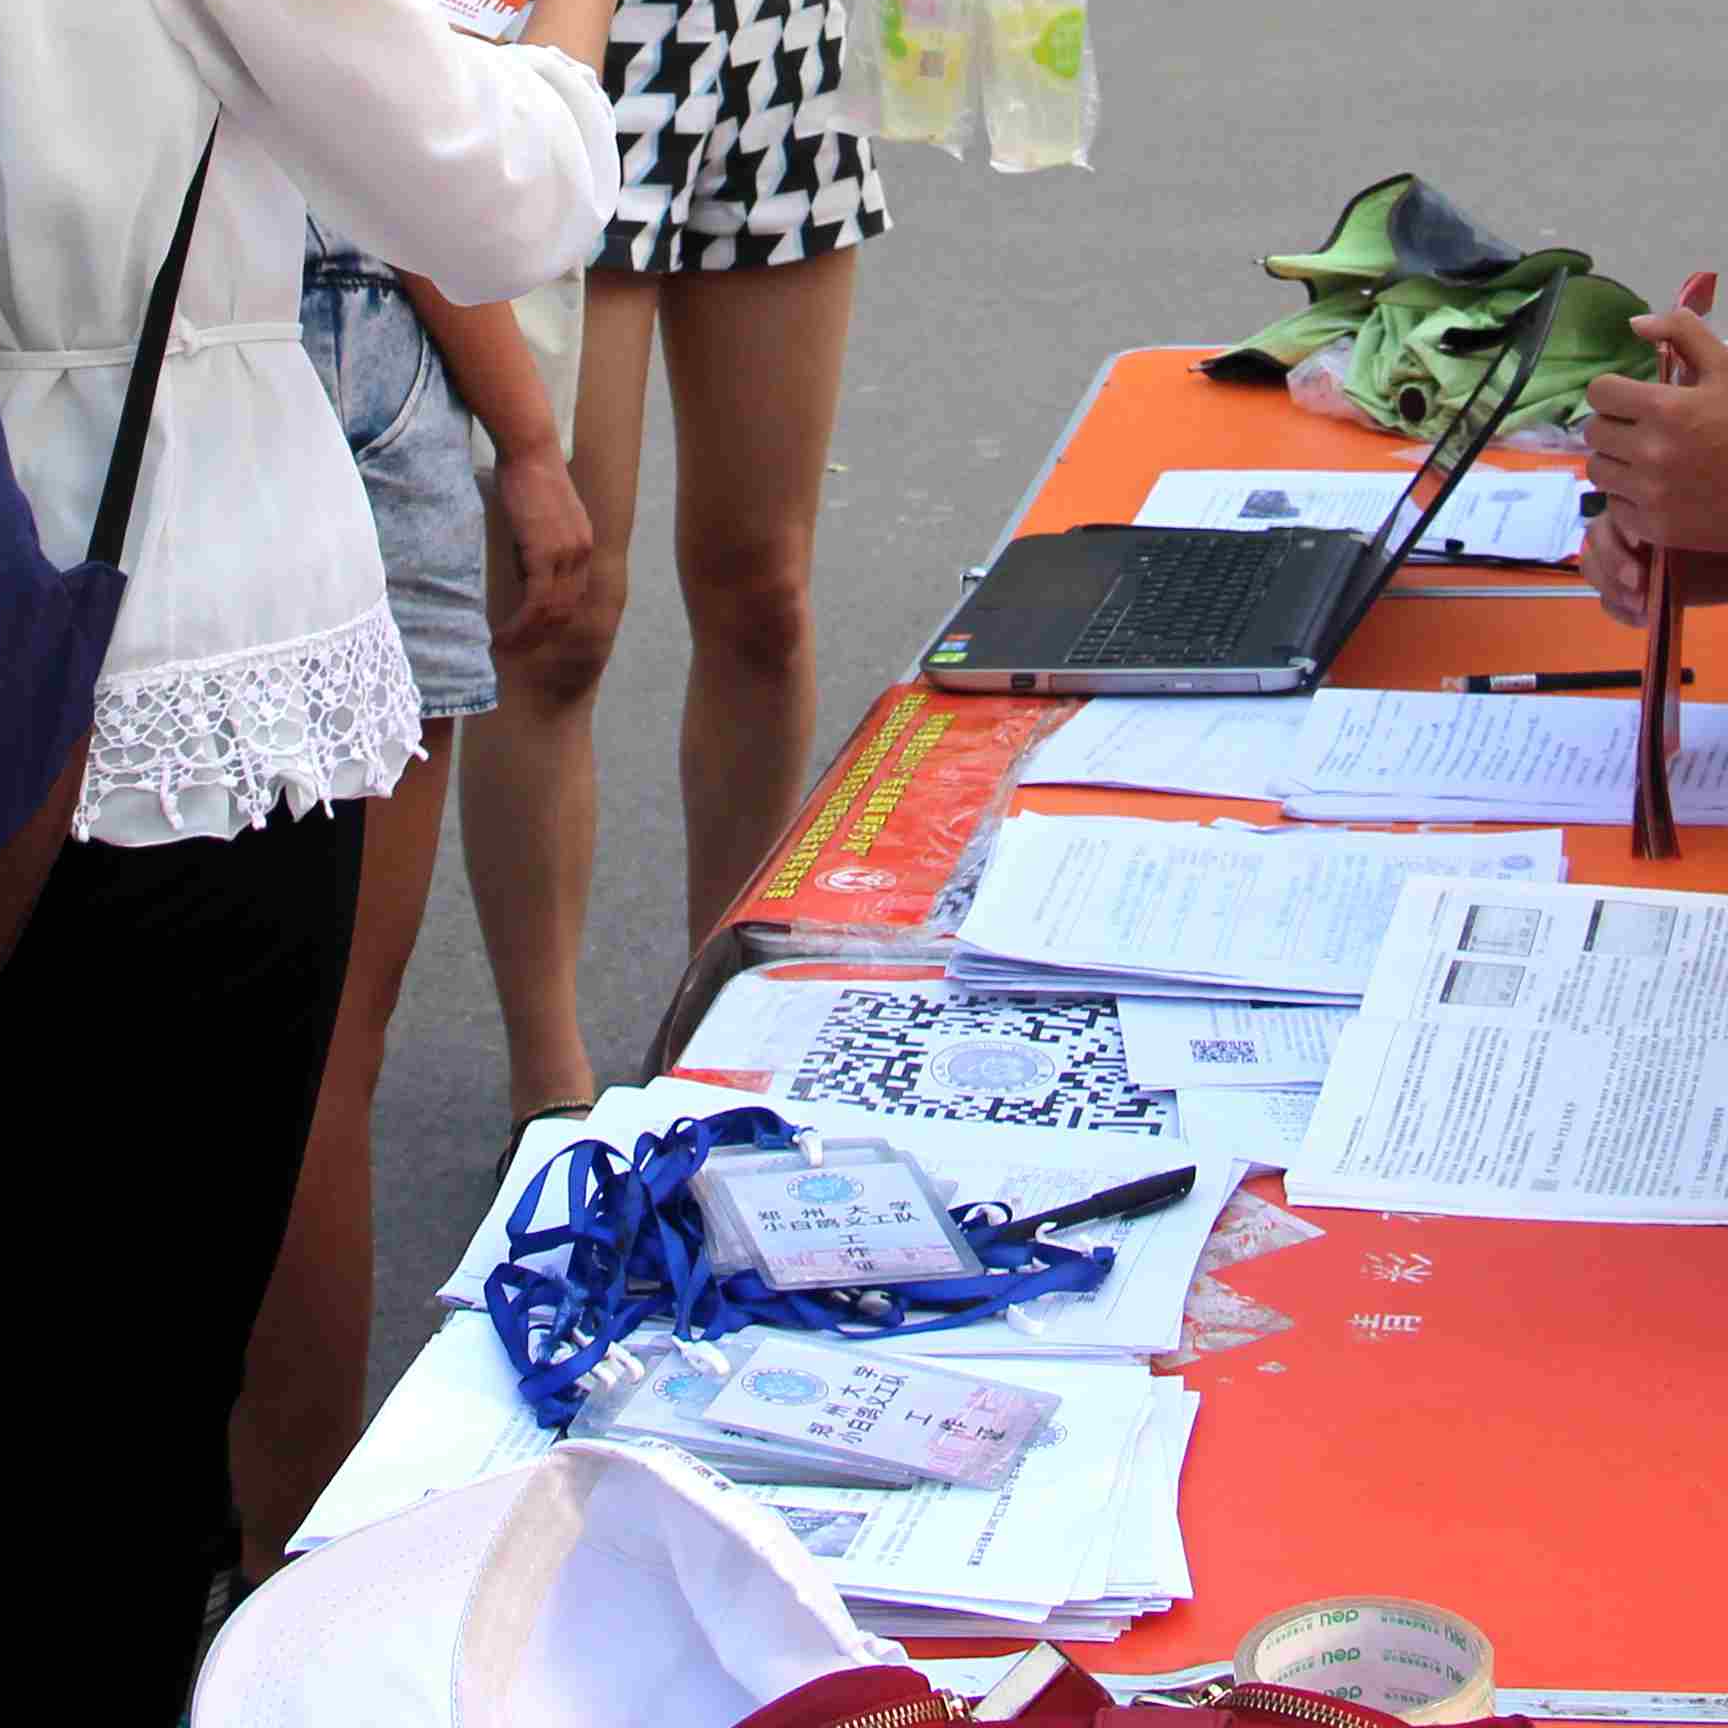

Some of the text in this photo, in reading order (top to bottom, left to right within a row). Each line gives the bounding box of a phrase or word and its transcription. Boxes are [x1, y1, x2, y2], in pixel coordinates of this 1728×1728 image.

[758, 1200, 912, 1221] 郑州大学
[807, 1365, 879, 1439] 郑州大学
